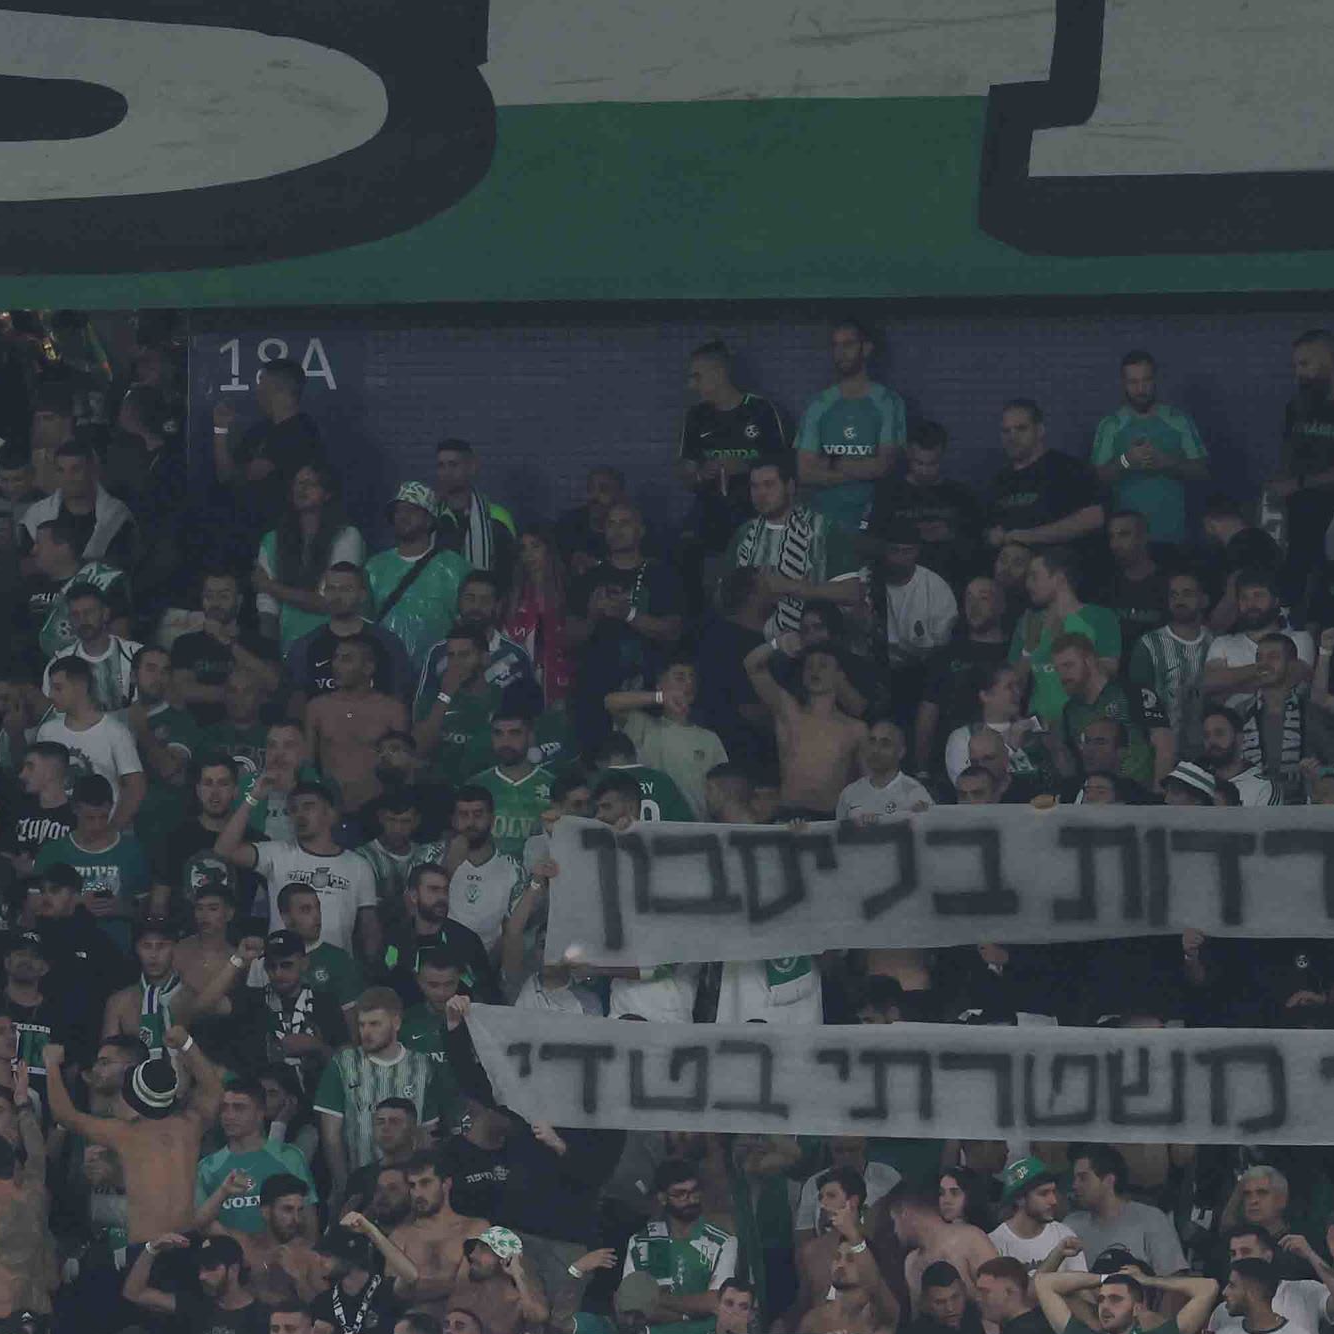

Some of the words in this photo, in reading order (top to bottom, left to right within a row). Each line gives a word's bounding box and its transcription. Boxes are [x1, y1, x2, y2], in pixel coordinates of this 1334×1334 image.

[580, 819, 1021, 952] בליסבון
[506, 1040, 791, 1121] בטדי
[814, 1044, 1288, 1135] משטרתי
